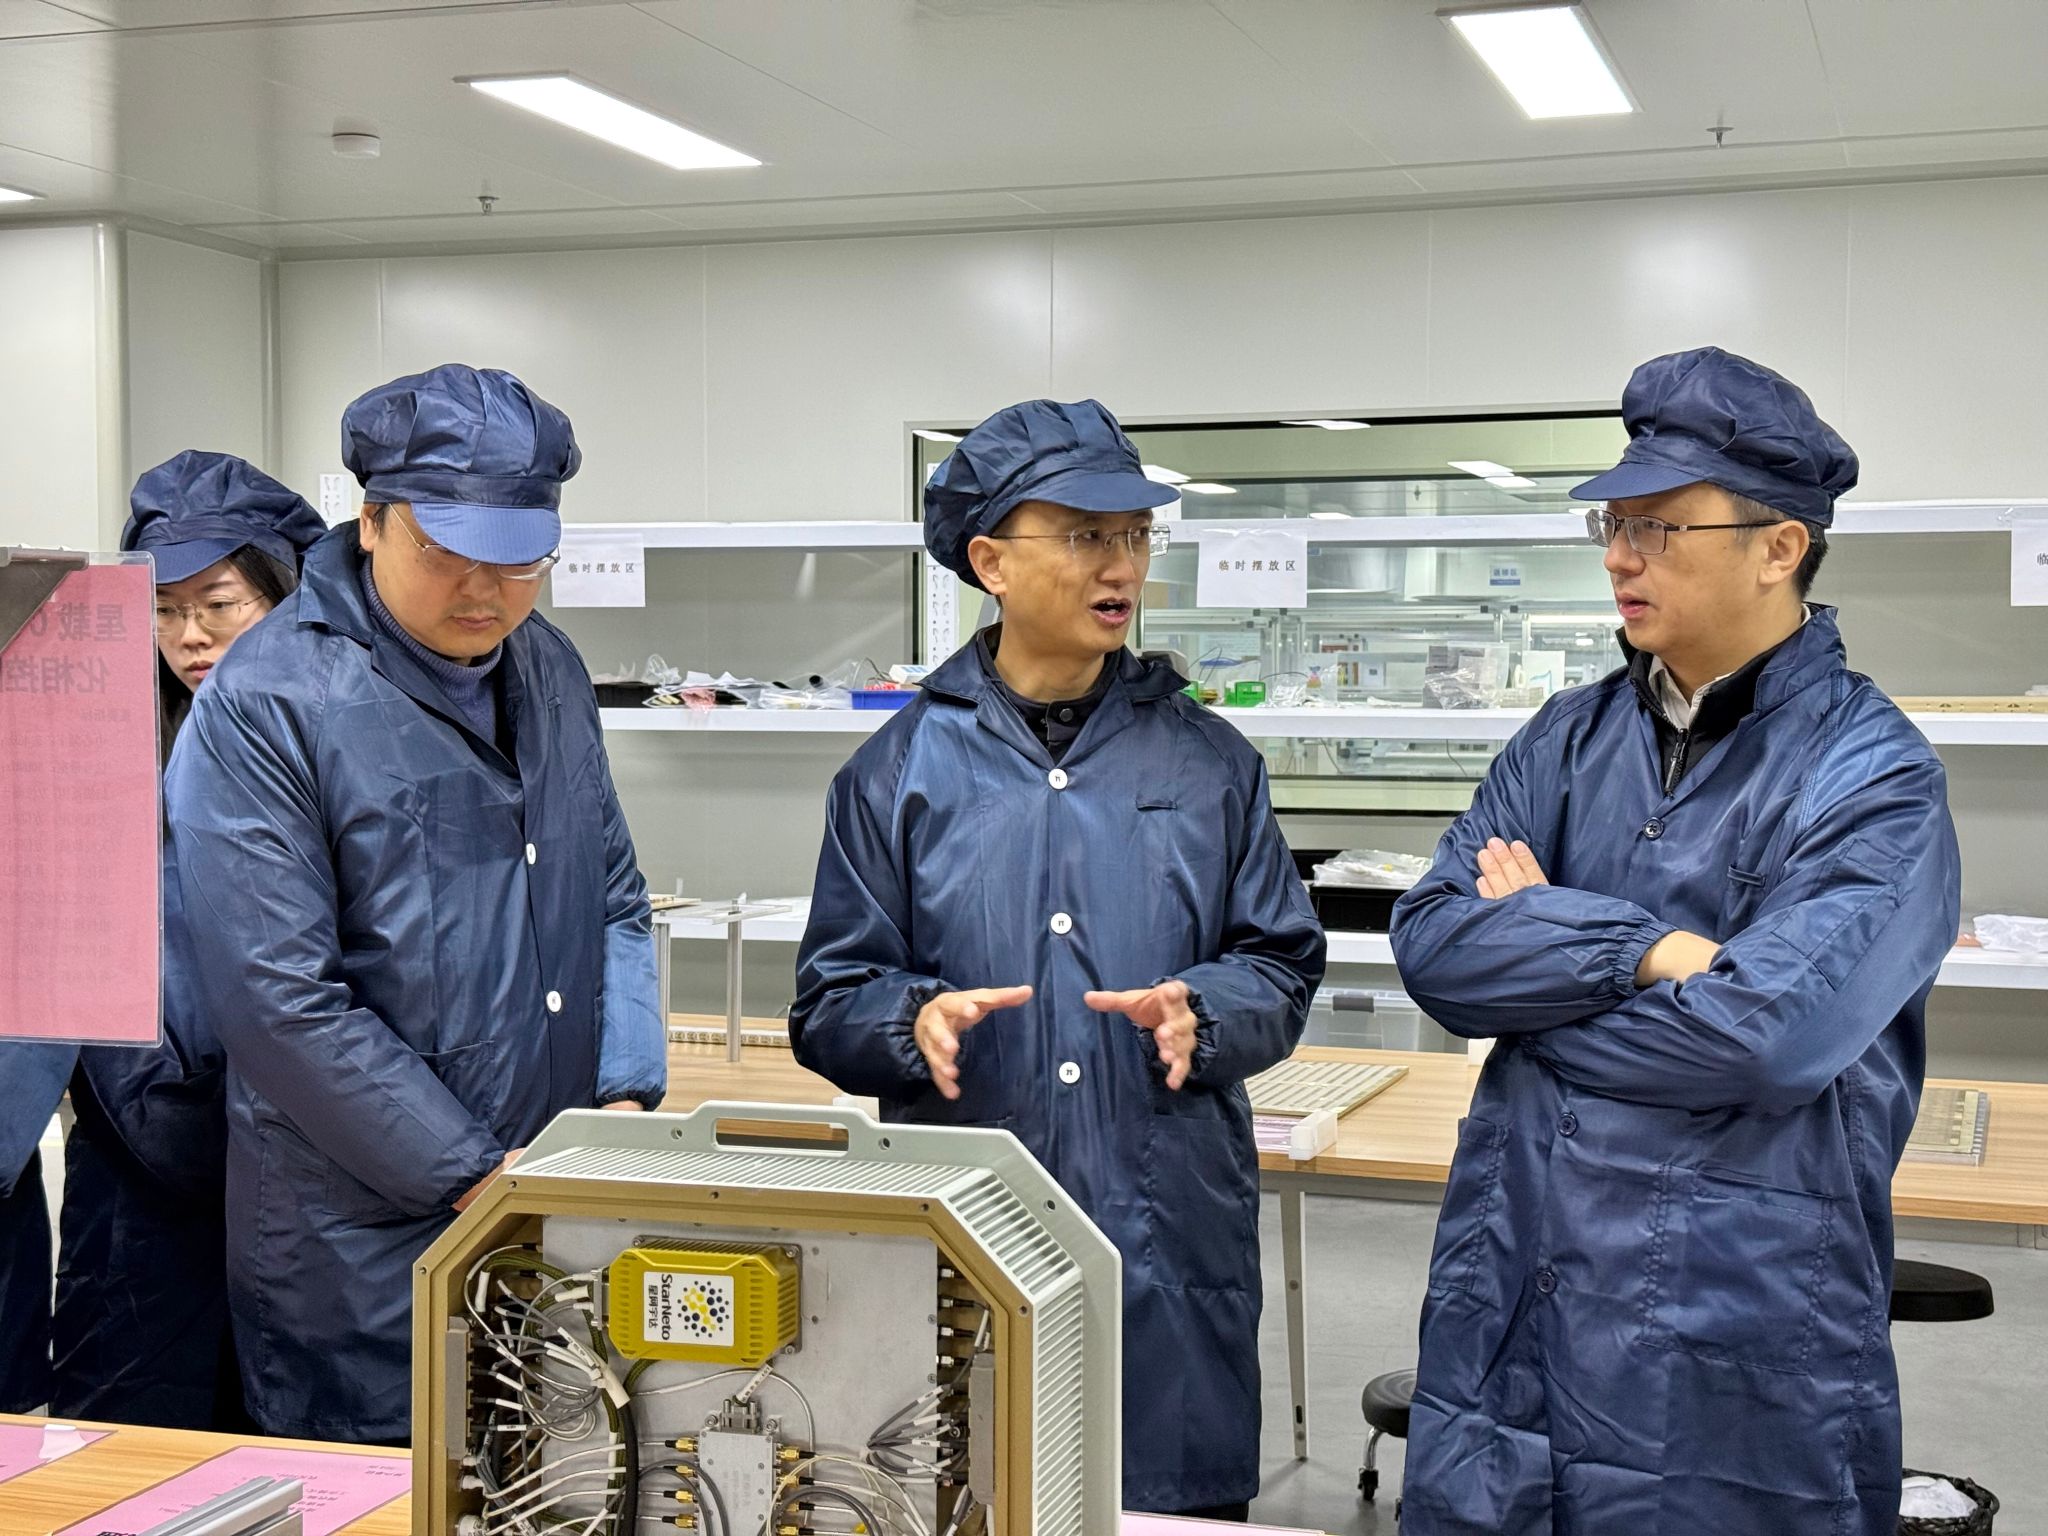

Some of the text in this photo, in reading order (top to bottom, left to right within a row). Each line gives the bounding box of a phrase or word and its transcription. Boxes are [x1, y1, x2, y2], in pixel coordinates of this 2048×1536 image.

[568, 563, 634, 573] 临时摆放区
[1219, 560, 1296, 571] 临时摆放区
[648, 1285, 658, 1328] 星网宇达
[661, 1274, 673, 1340] StarNeto
